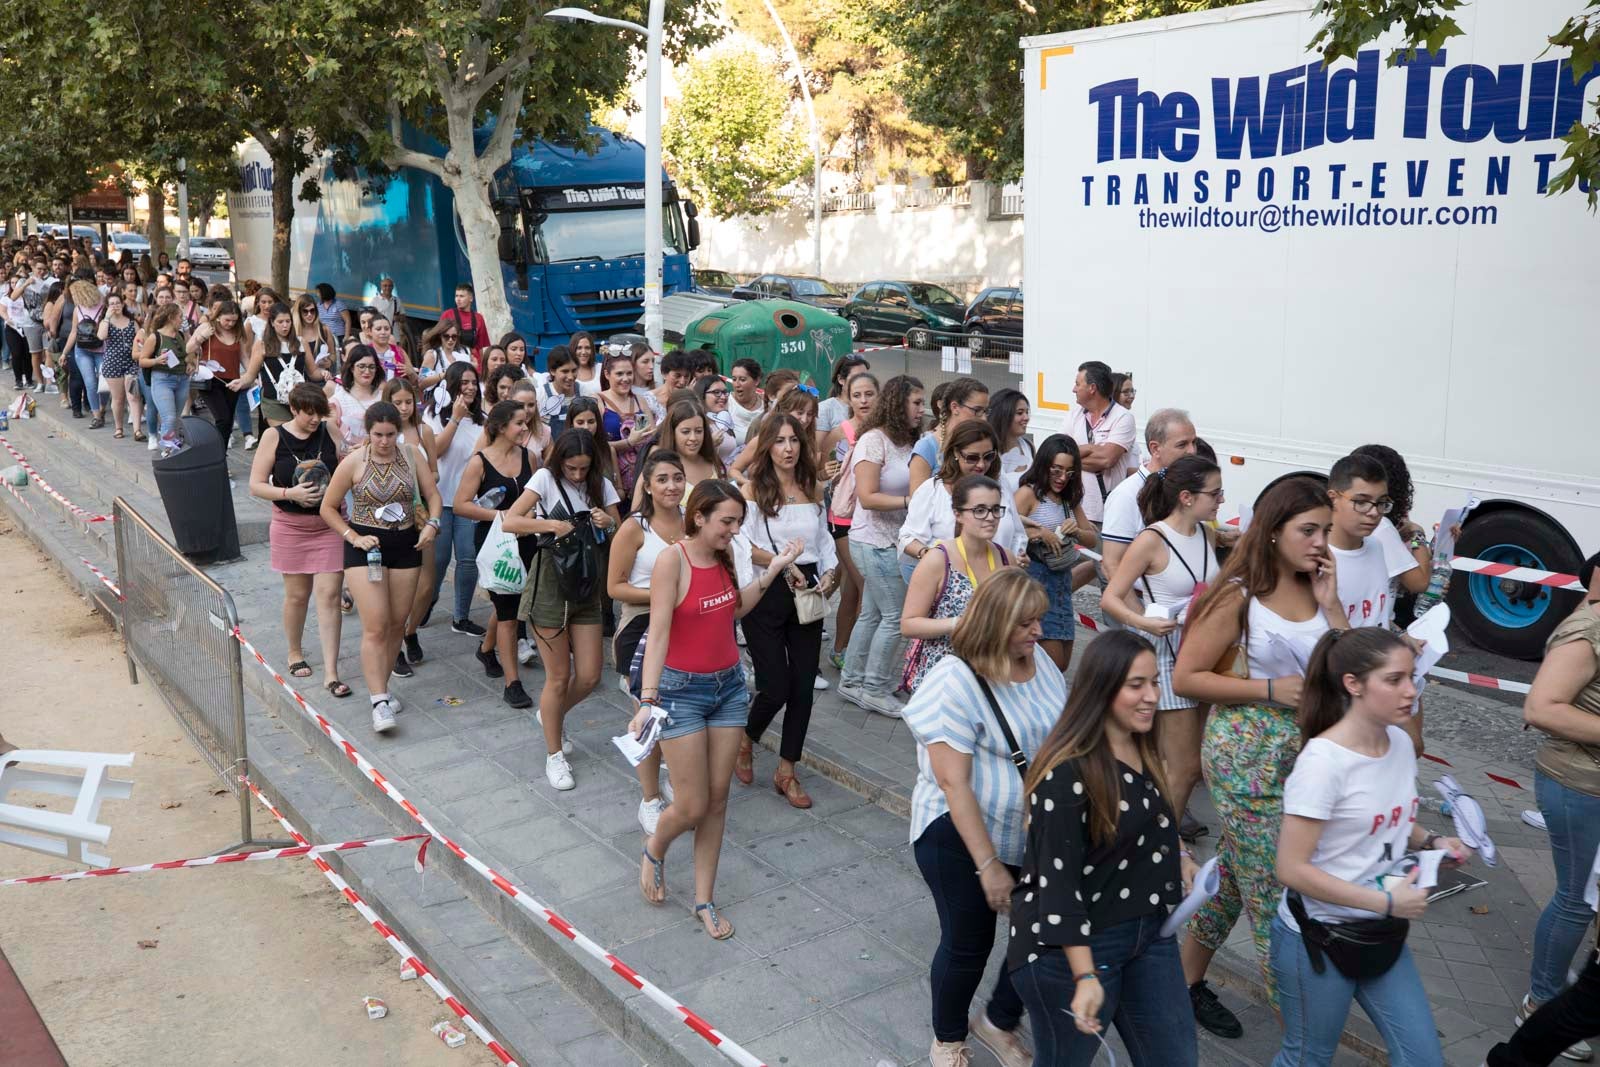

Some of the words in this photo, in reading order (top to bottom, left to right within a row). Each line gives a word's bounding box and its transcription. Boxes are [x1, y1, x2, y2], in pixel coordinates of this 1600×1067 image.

[1089, 78, 1200, 163] The
[1211, 49, 1380, 160] Wild
[1395, 48, 1600, 144] Tour
[1082, 153, 1600, 206] TRANSPORT-EVENT
[563, 188, 589, 203] The
[588, 187, 618, 202] Wild
[1139, 203, 1498, 233] thewildtour@thewildtour.com
[599, 287, 645, 301] IVECO
[703, 591, 734, 609] FEMME
